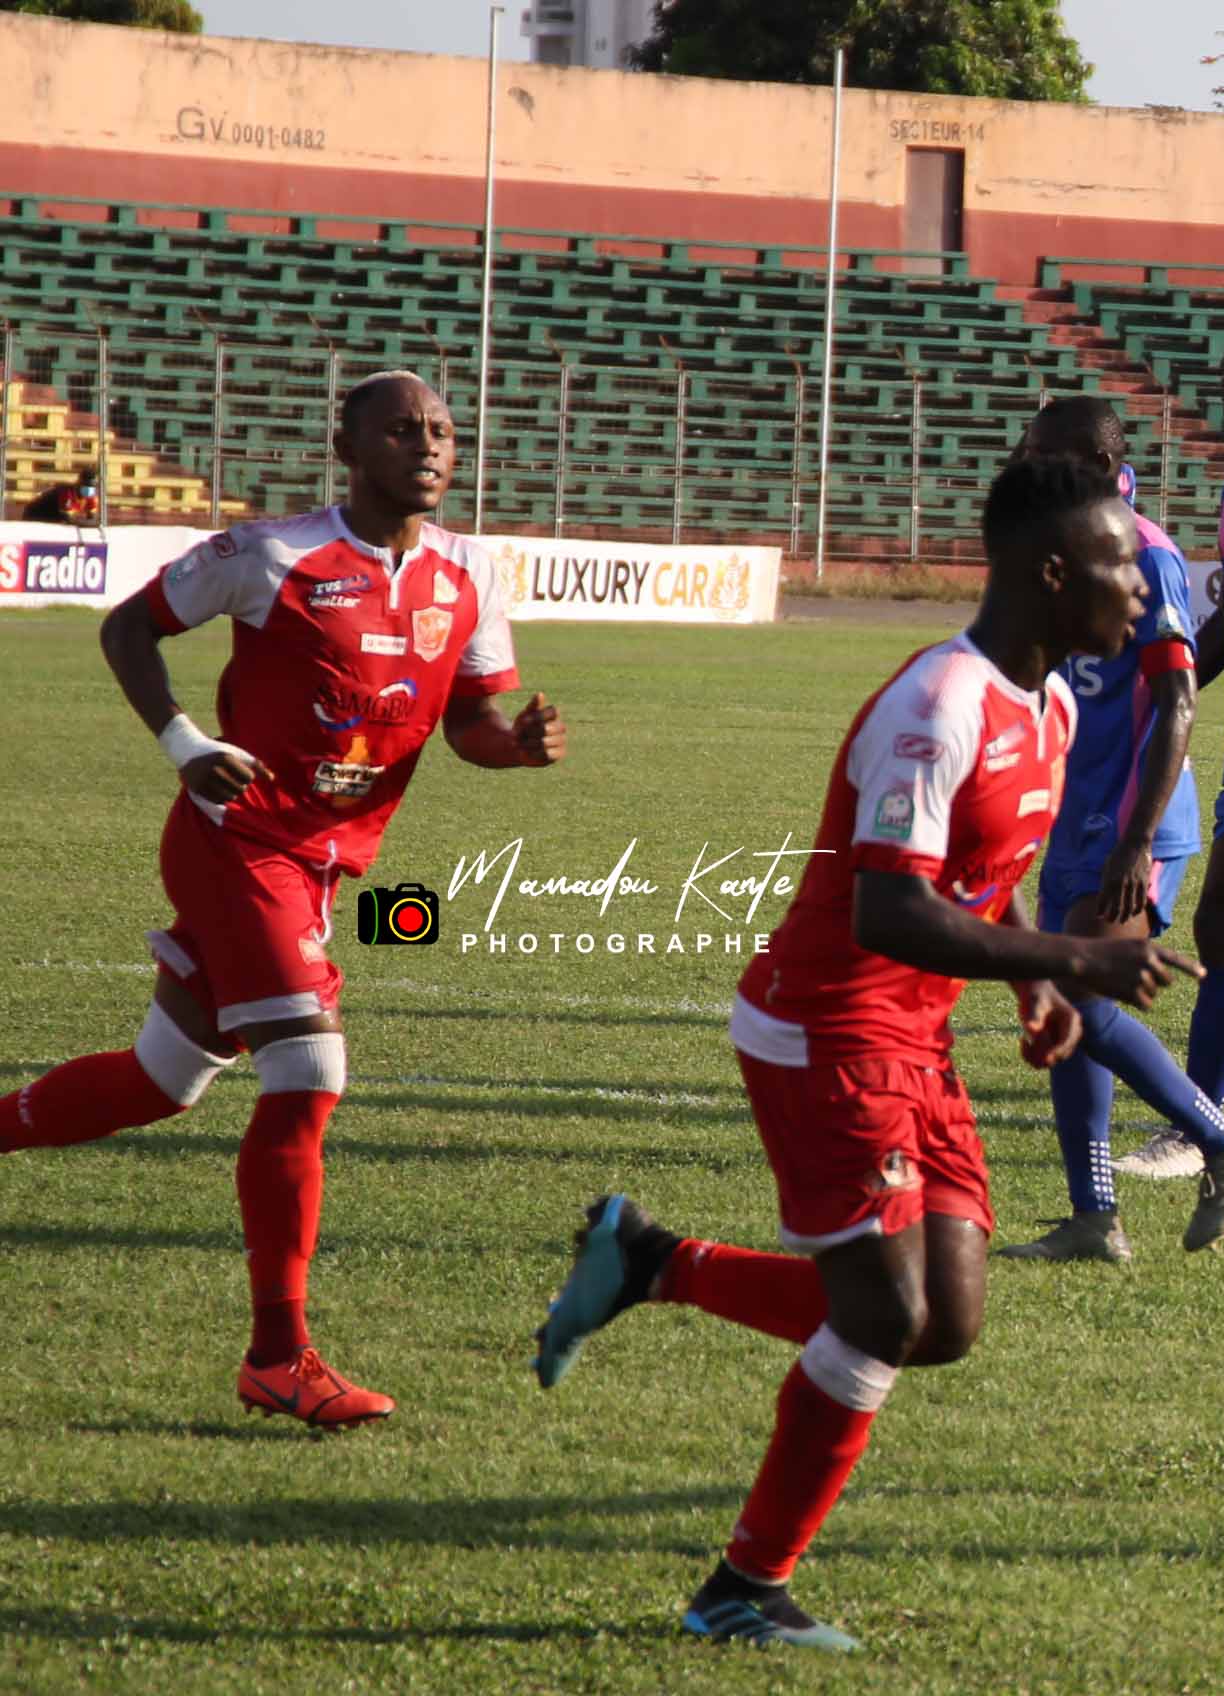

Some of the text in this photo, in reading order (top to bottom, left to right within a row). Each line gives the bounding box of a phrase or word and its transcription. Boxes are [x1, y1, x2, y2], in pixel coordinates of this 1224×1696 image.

[26, 546, 104, 590] radio
[531, 556, 709, 609] LUXURY CAR
